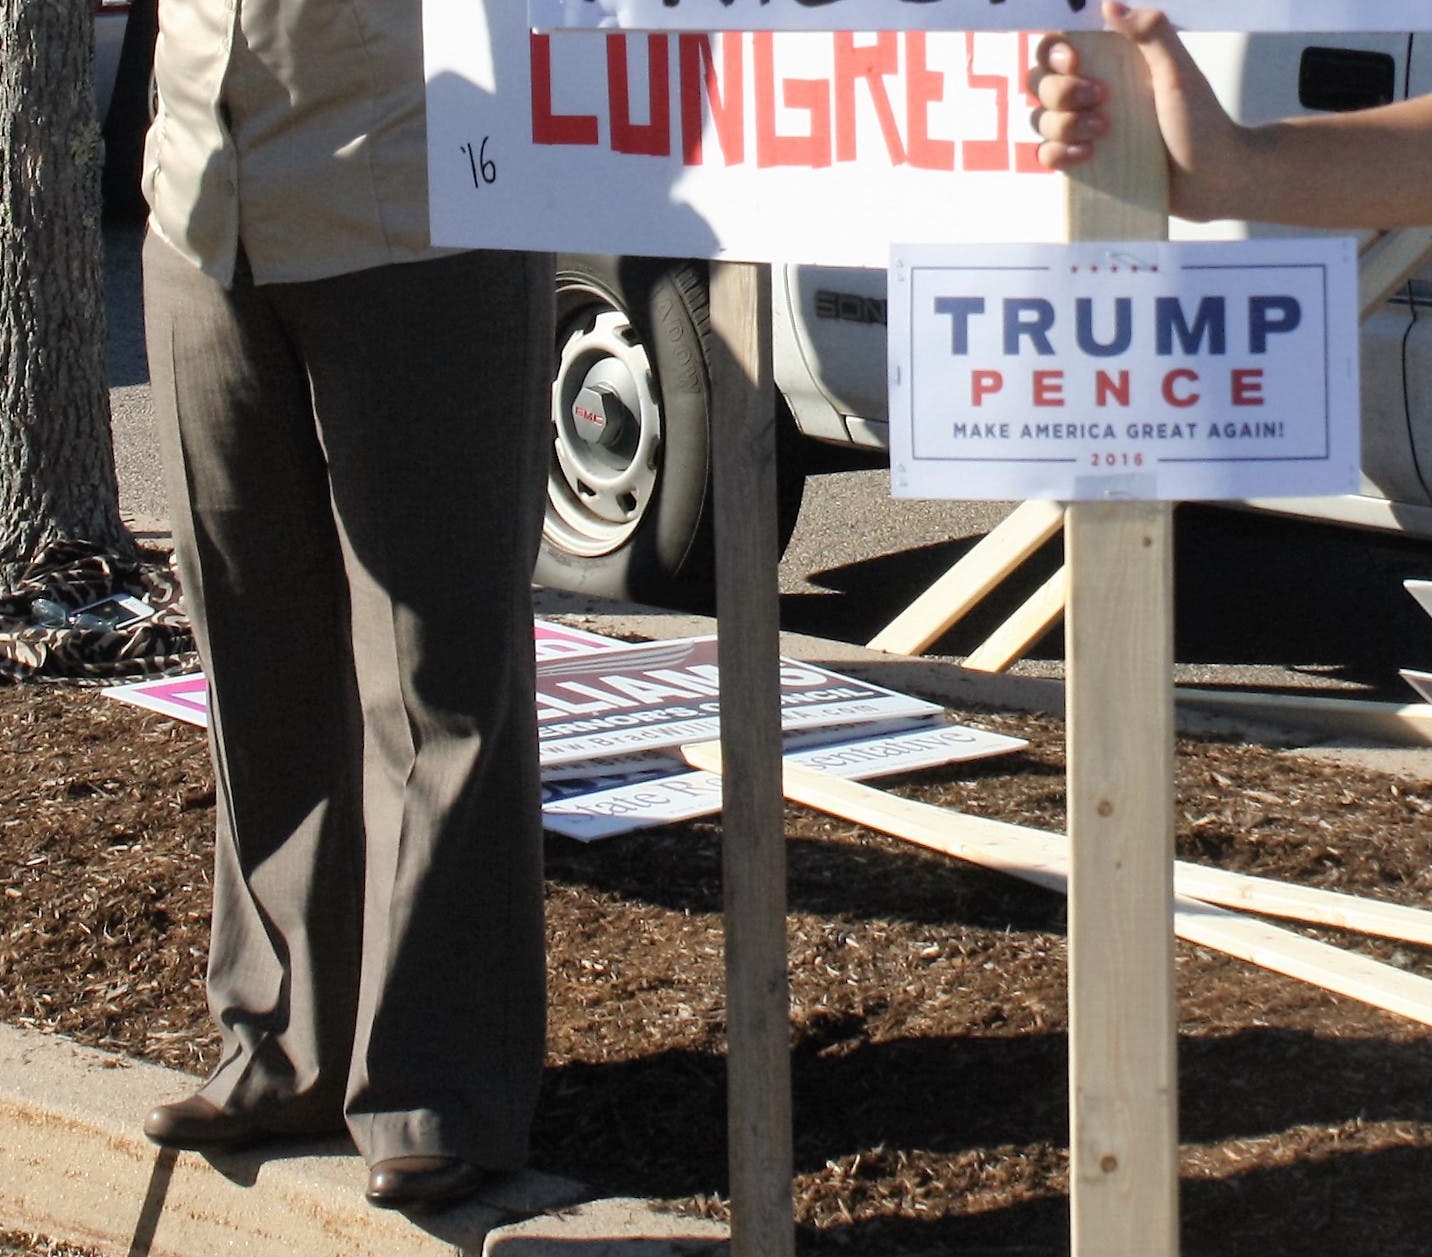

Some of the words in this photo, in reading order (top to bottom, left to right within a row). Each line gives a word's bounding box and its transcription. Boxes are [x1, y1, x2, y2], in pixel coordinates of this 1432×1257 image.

[461, 137, 497, 189] '16
[934, 295, 1302, 358] TRUMP
[970, 367, 1266, 408] PENCE
[952, 423, 1010, 440] MAKE
[1020, 423, 1115, 440] AMERICA
[1125, 423, 1198, 440] GREAT
[1208, 422, 1286, 440] AGAIN!
[1091, 452, 1145, 467] 2016
